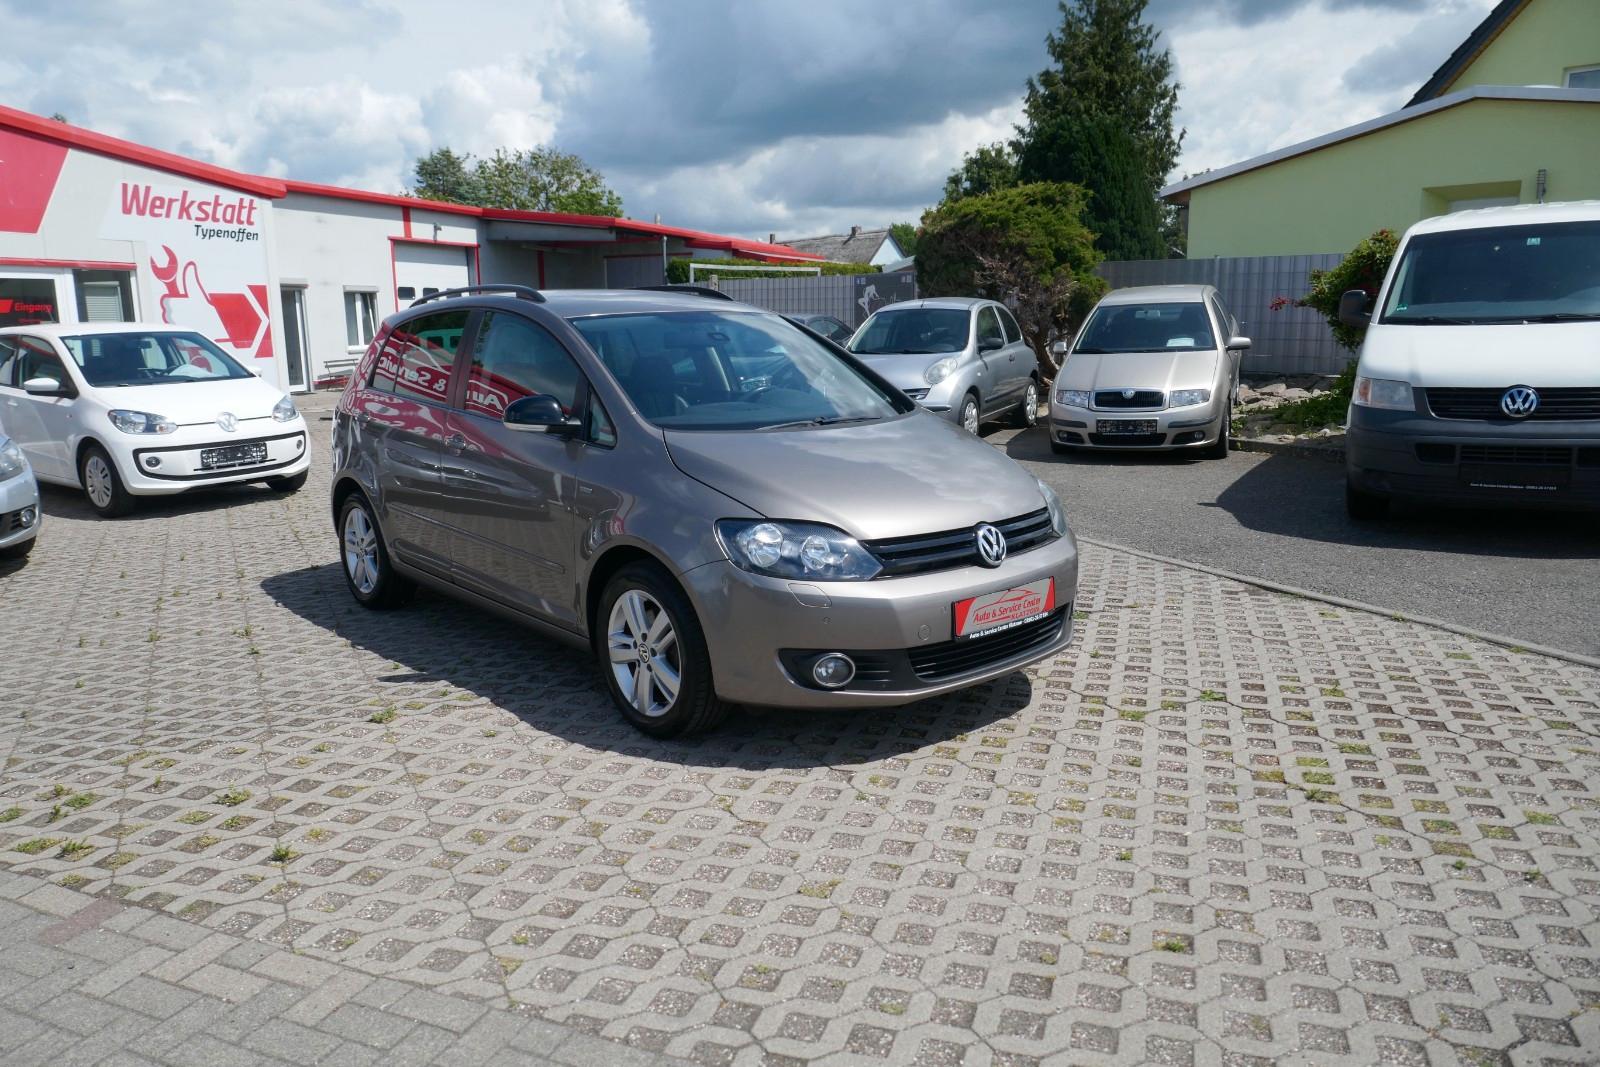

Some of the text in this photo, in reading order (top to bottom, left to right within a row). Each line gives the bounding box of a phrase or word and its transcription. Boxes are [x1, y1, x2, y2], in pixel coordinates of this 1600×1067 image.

[121, 182, 258, 226] Werkstatt
[194, 224, 259, 242] Typenoffen
[974, 609, 990, 623] Auto
[998, 602, 1022, 615] Service
